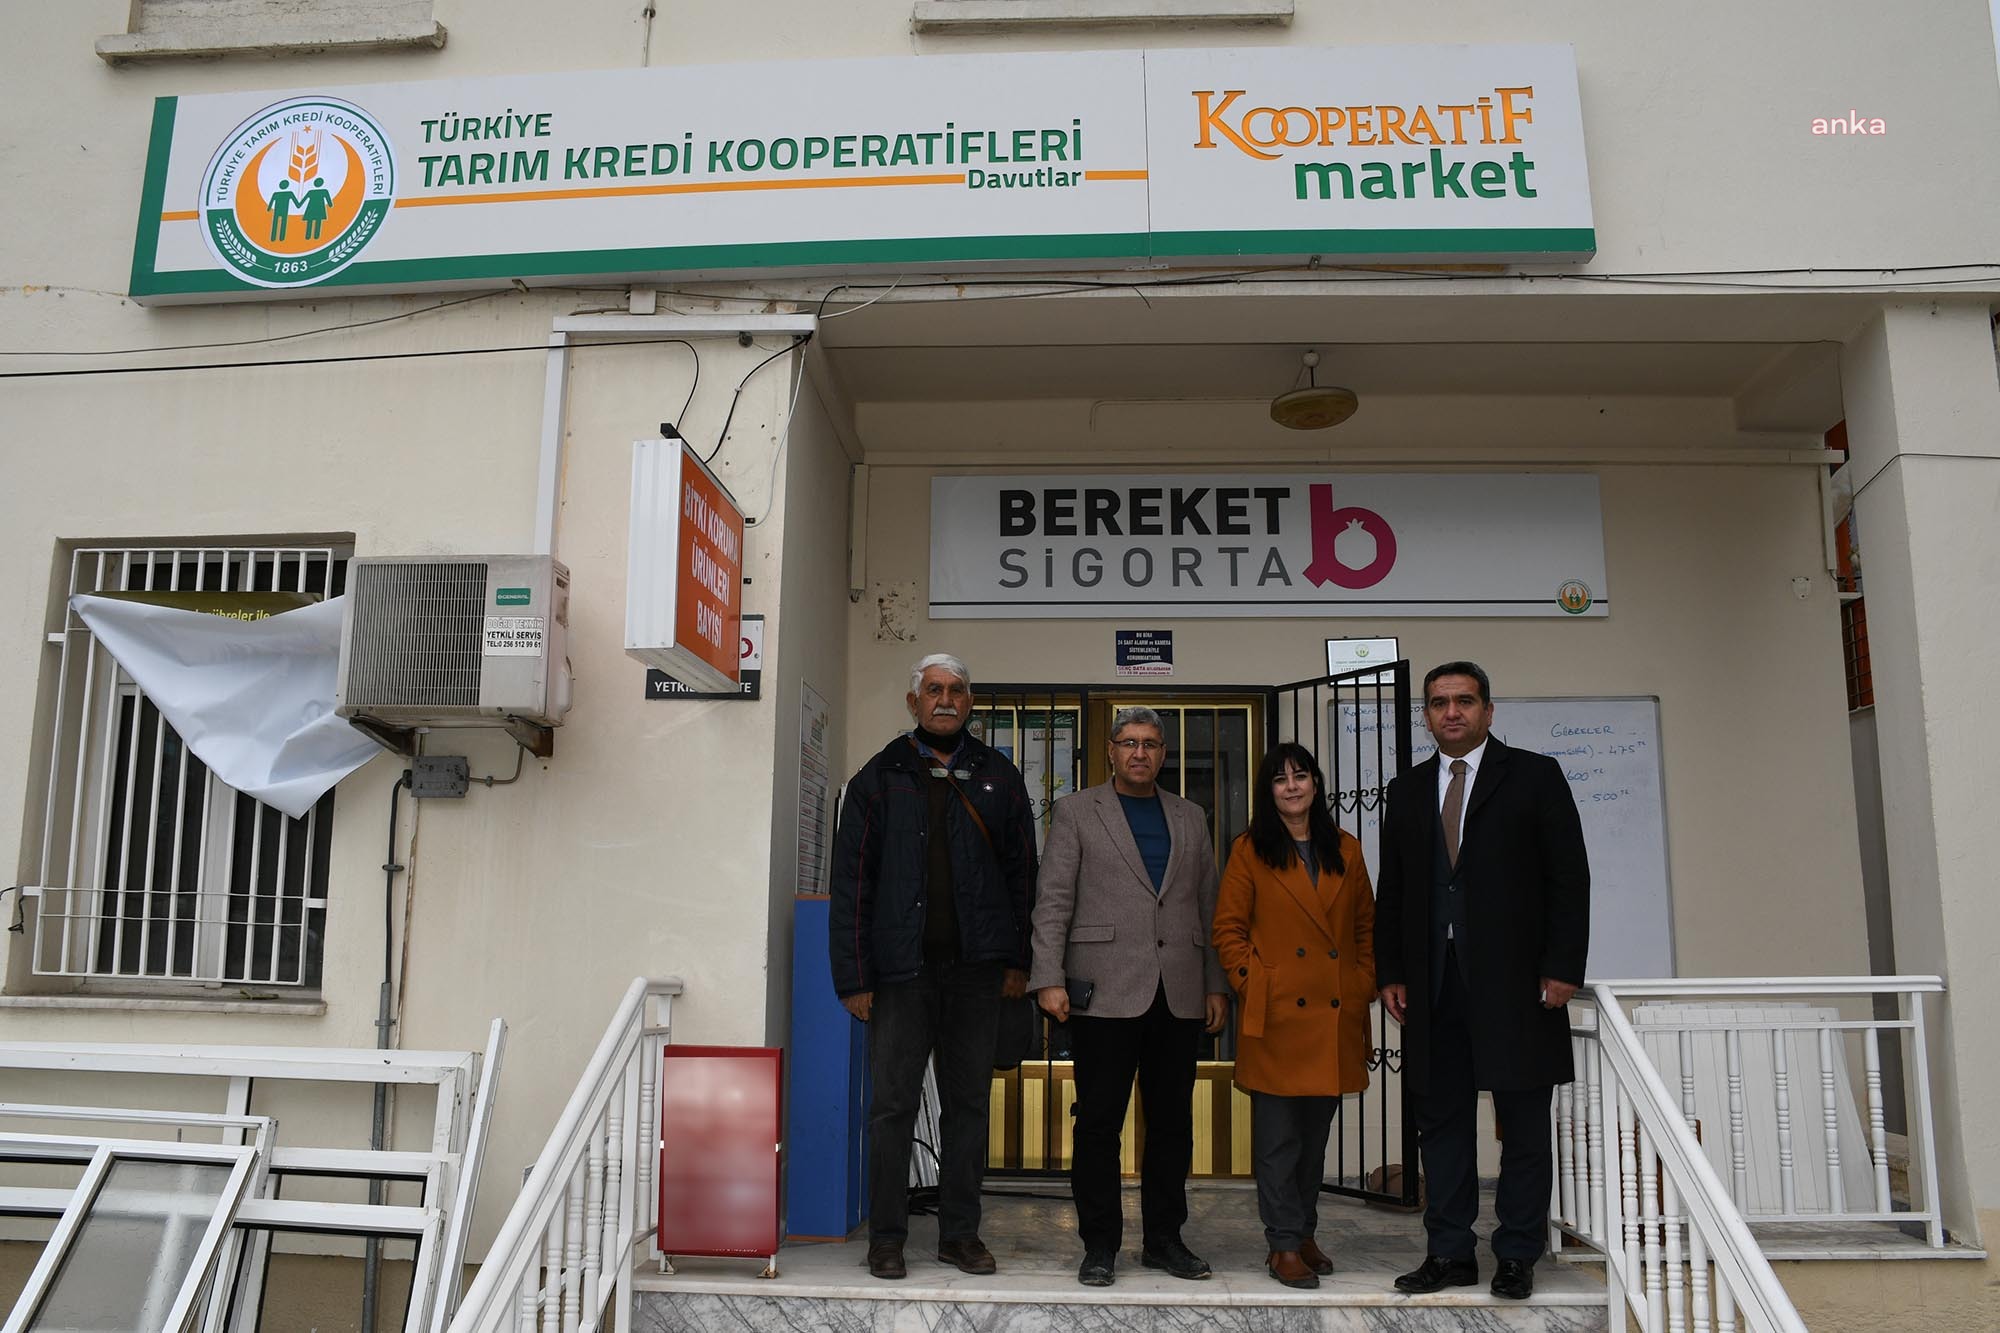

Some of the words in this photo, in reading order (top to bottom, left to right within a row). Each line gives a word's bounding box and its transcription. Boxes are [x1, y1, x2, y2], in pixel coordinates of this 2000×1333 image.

[420, 108, 553, 144] TÜRKİYE
[1191, 85, 1534, 161] KOOPERATİF
[217, 149, 246, 203] TÜRKİYE
[243, 120, 281, 149] TARIM
[282, 111, 324, 127] KREDİ
[325, 113, 385, 195] KOOPERATİFLERİ
[417, 149, 551, 188] TARIM
[563, 132, 694, 180] KREDİ
[707, 118, 1082, 173] KOOPERATİFLERİ
[967, 166, 1082, 190] Davutlar
[1294, 148, 1538, 200] market
[273, 260, 309, 274] 1863
[684, 479, 708, 535] BİTKİ
[707, 507, 739, 567] KORUMA
[999, 486, 1291, 537] BEREKET
[691, 535, 731, 607] ÜRÜNLERİ
[487, 630, 515, 639] YETKİLİ
[516, 630, 542, 640] SERVİS
[503, 640, 513, 648] 256
[515, 640, 525, 648] 512
[696, 600, 723, 649] BAYİSİ
